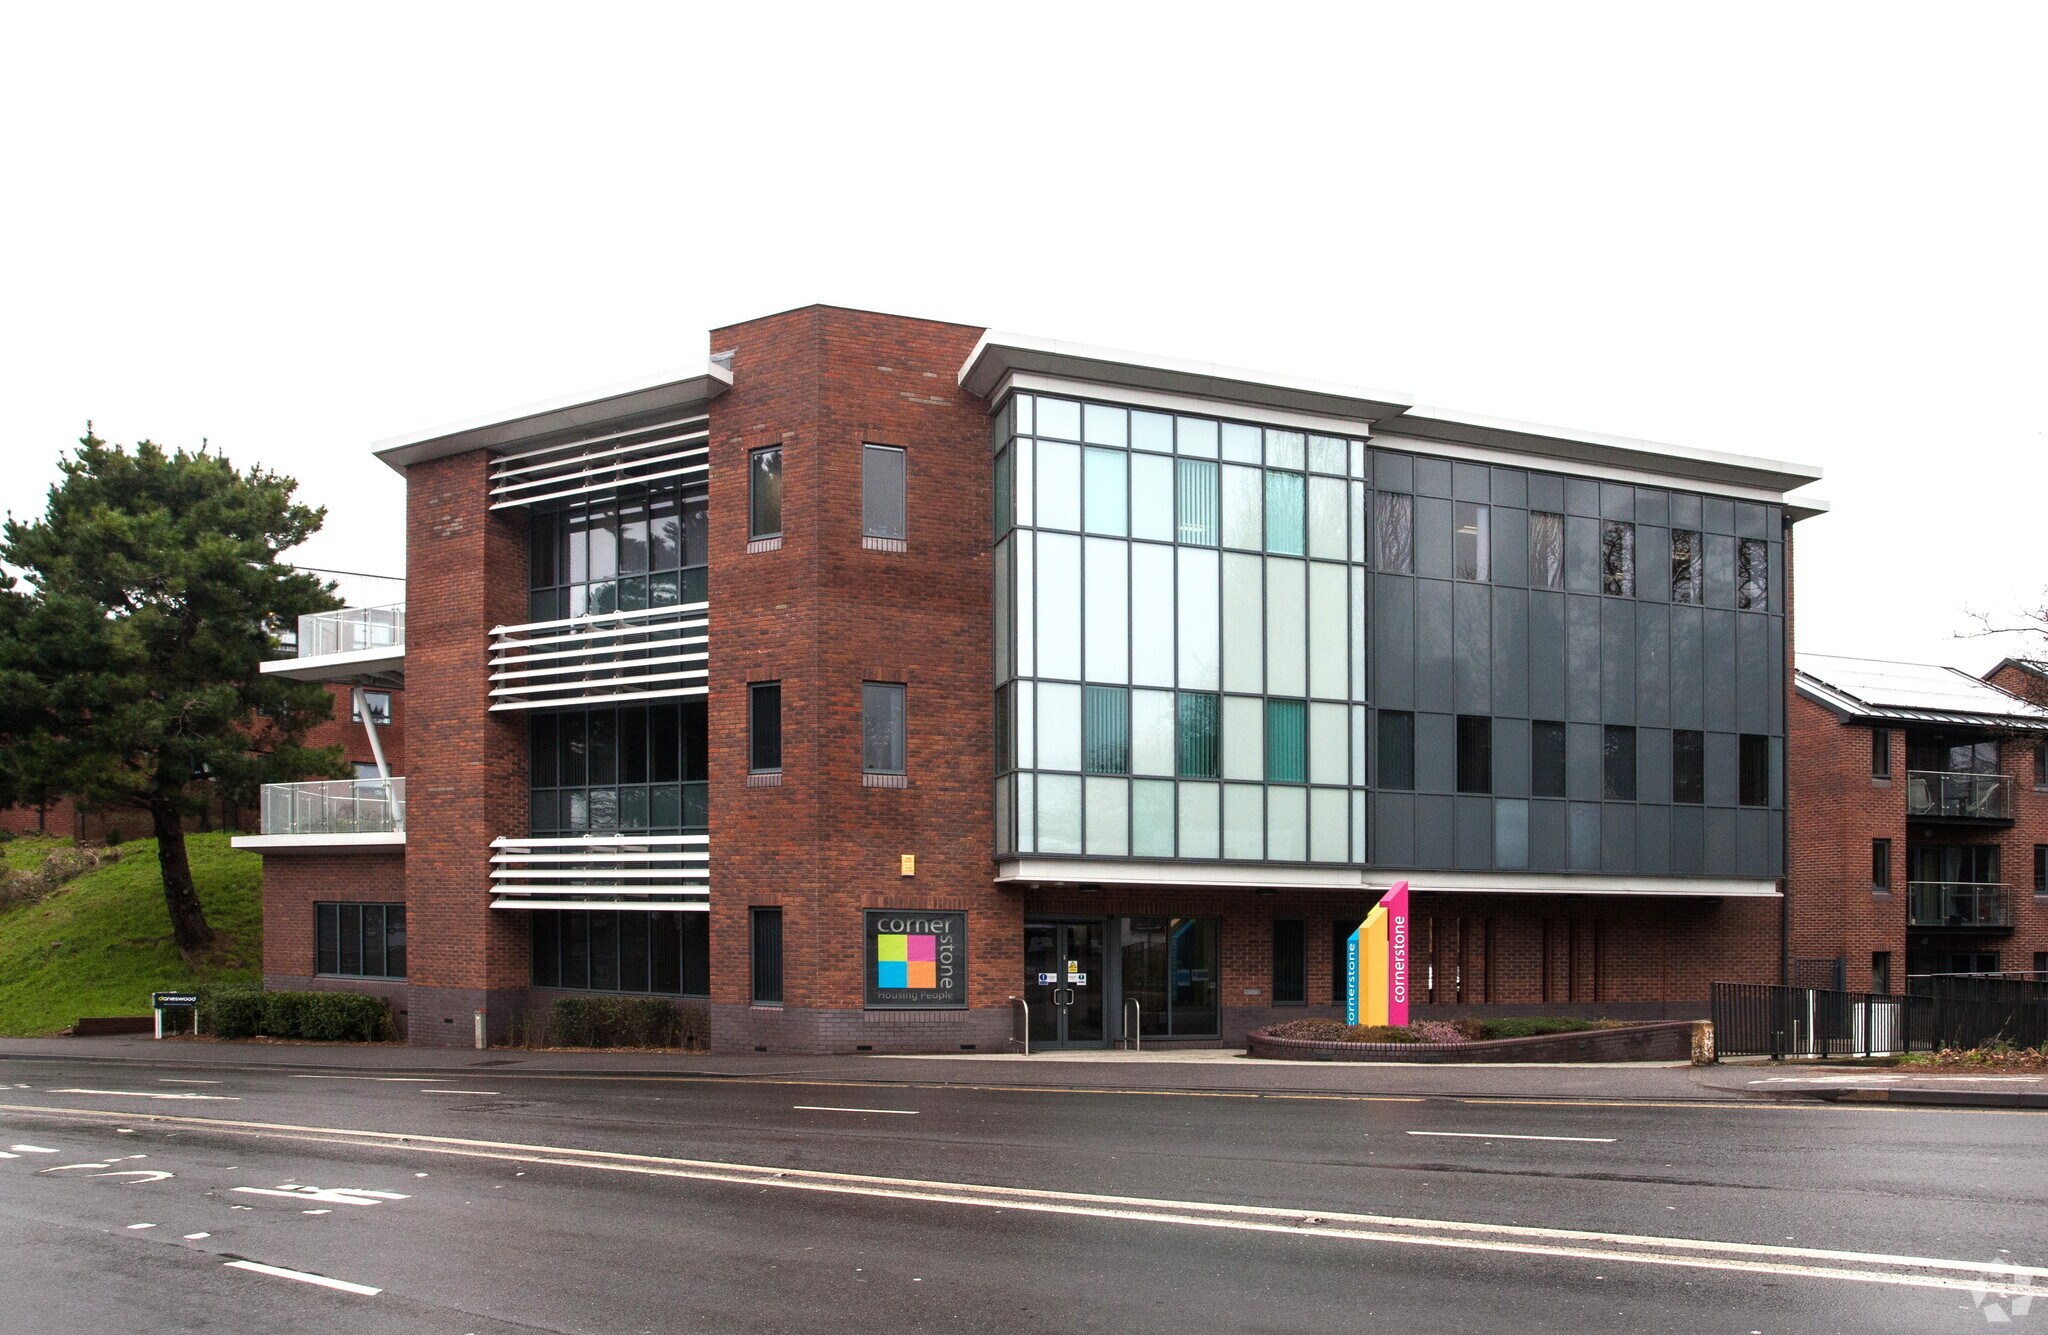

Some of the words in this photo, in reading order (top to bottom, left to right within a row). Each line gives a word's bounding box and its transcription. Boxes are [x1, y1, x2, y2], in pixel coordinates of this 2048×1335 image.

[877, 918, 953, 933] corner
[940, 935, 955, 989] stone
[1393, 916, 1405, 1003] cornerstone
[878, 991, 918, 1001] Housing
[920, 991, 954, 1001] People
